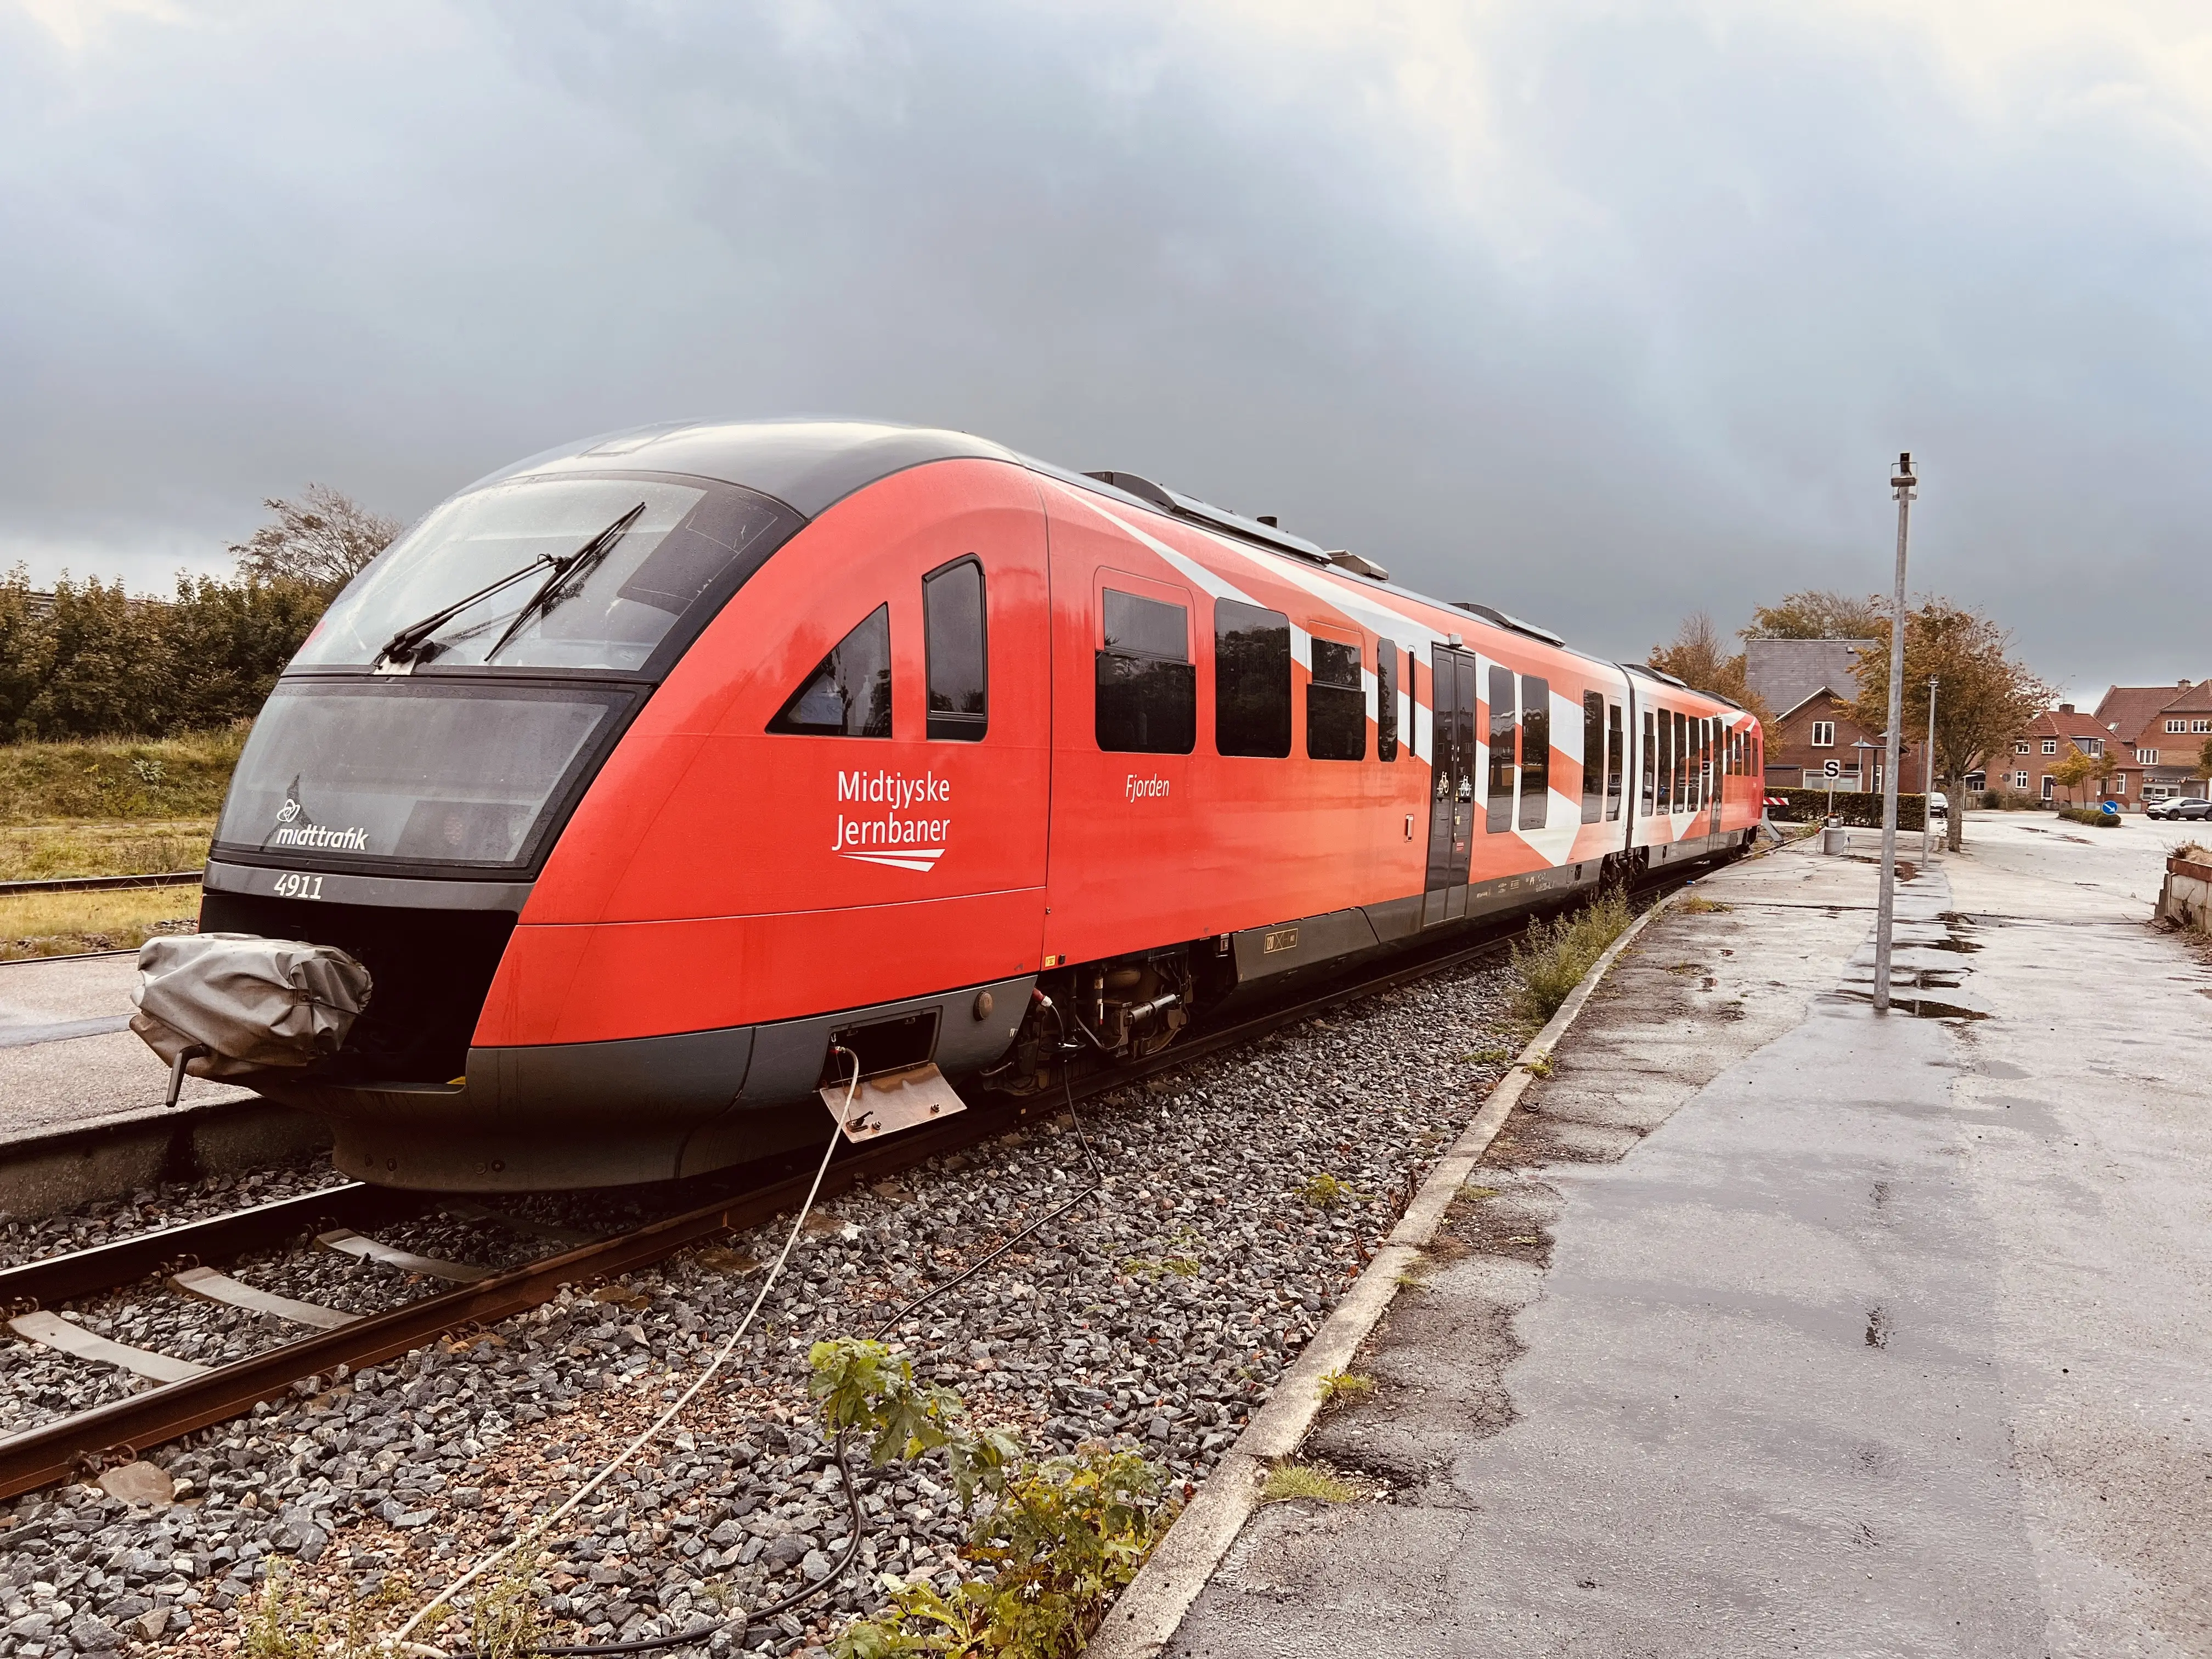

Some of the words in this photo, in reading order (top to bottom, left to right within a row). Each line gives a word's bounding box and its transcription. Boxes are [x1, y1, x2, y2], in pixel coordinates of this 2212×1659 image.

[1825, 761, 1838, 777] S
[838, 770, 950, 809] Midtjyske
[1126, 773, 1170, 803] Fjorden
[276, 824, 369, 850] midttrafik
[831, 812, 950, 851] Jernbaner
[274, 873, 323, 900] 4911
